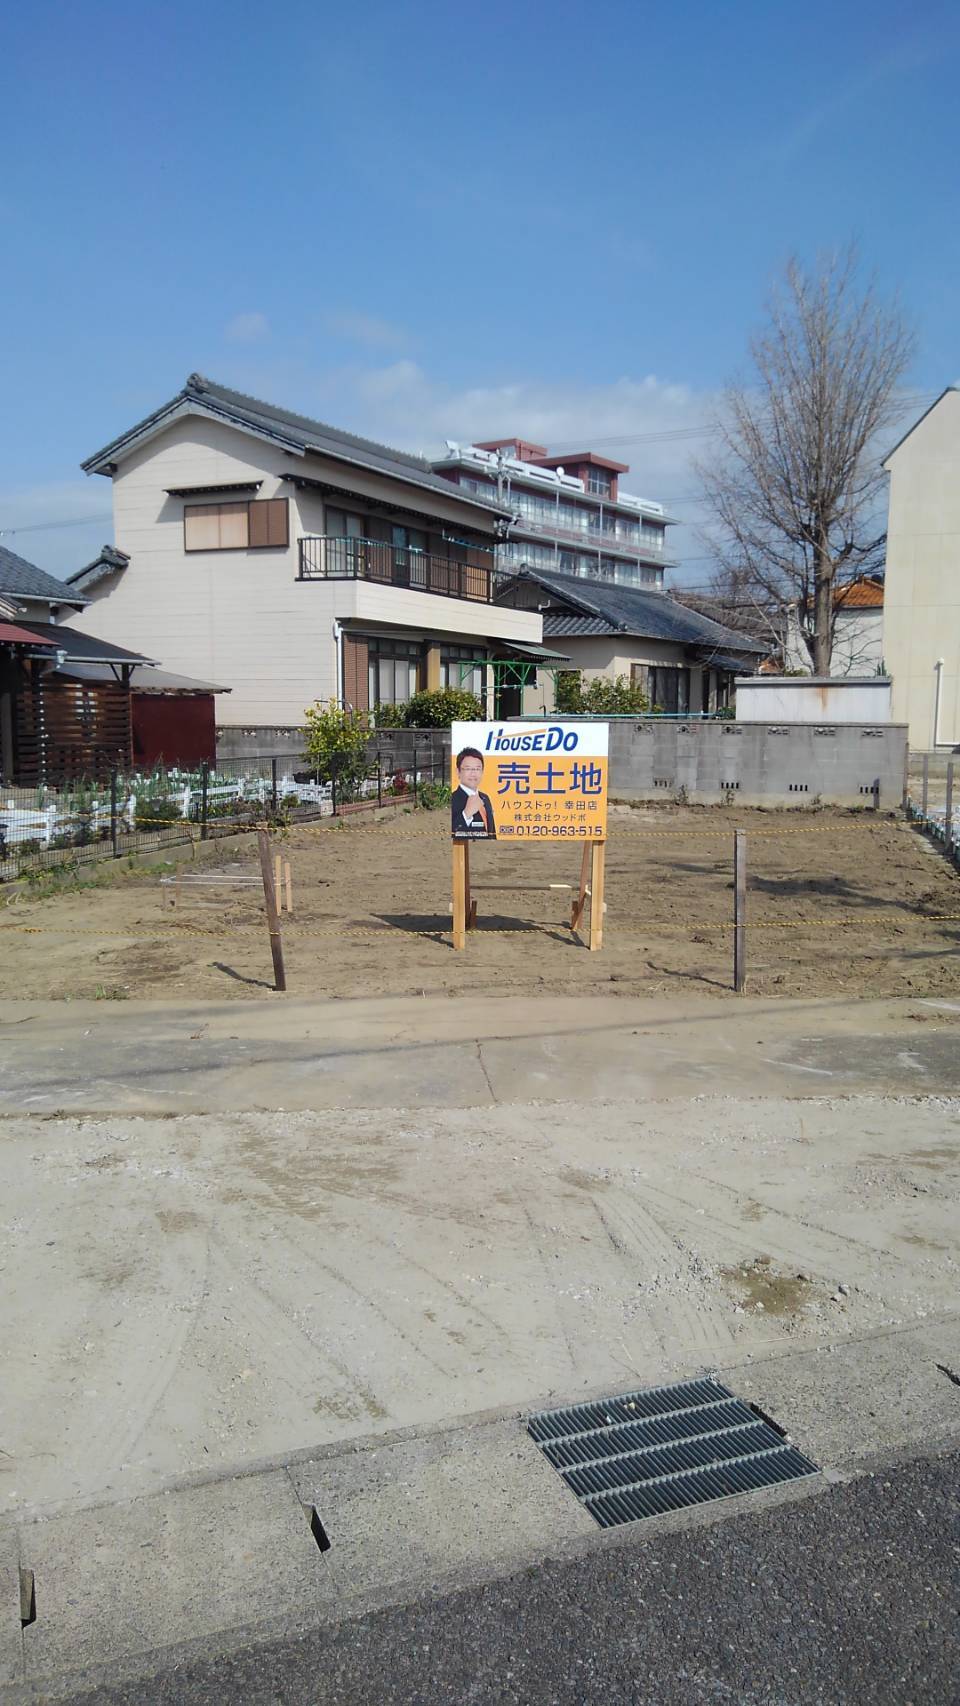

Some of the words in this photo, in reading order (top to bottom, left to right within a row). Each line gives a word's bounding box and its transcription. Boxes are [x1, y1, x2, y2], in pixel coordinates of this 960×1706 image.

[497, 762, 602, 795] 売土地
[565, 801, 597, 810] 幸田店
[516, 826, 602, 837] 0120-963-515
